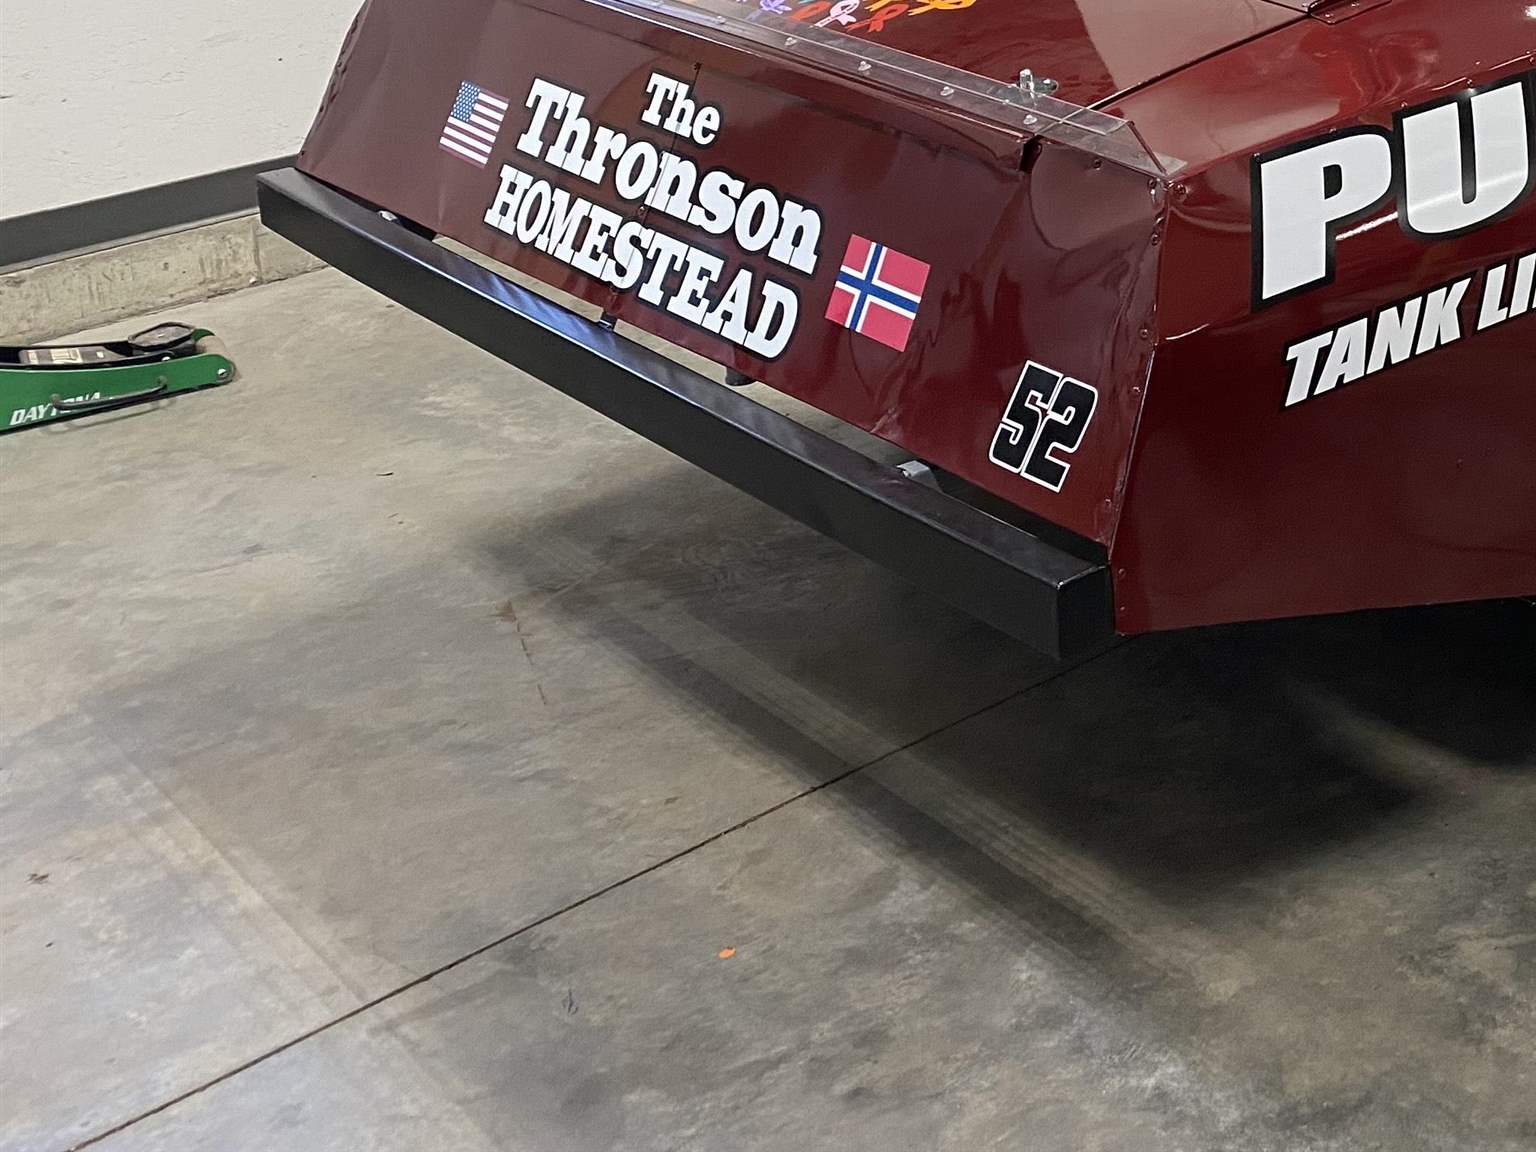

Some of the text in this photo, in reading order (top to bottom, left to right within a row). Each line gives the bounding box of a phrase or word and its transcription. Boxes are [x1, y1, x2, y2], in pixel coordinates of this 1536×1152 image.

[641, 72, 721, 145] The
[516, 77, 823, 275] Thronson
[484, 164, 799, 360] HOMESTEAD
[1284, 280, 1474, 408] TANK
[989, 360, 1098, 493] 52
